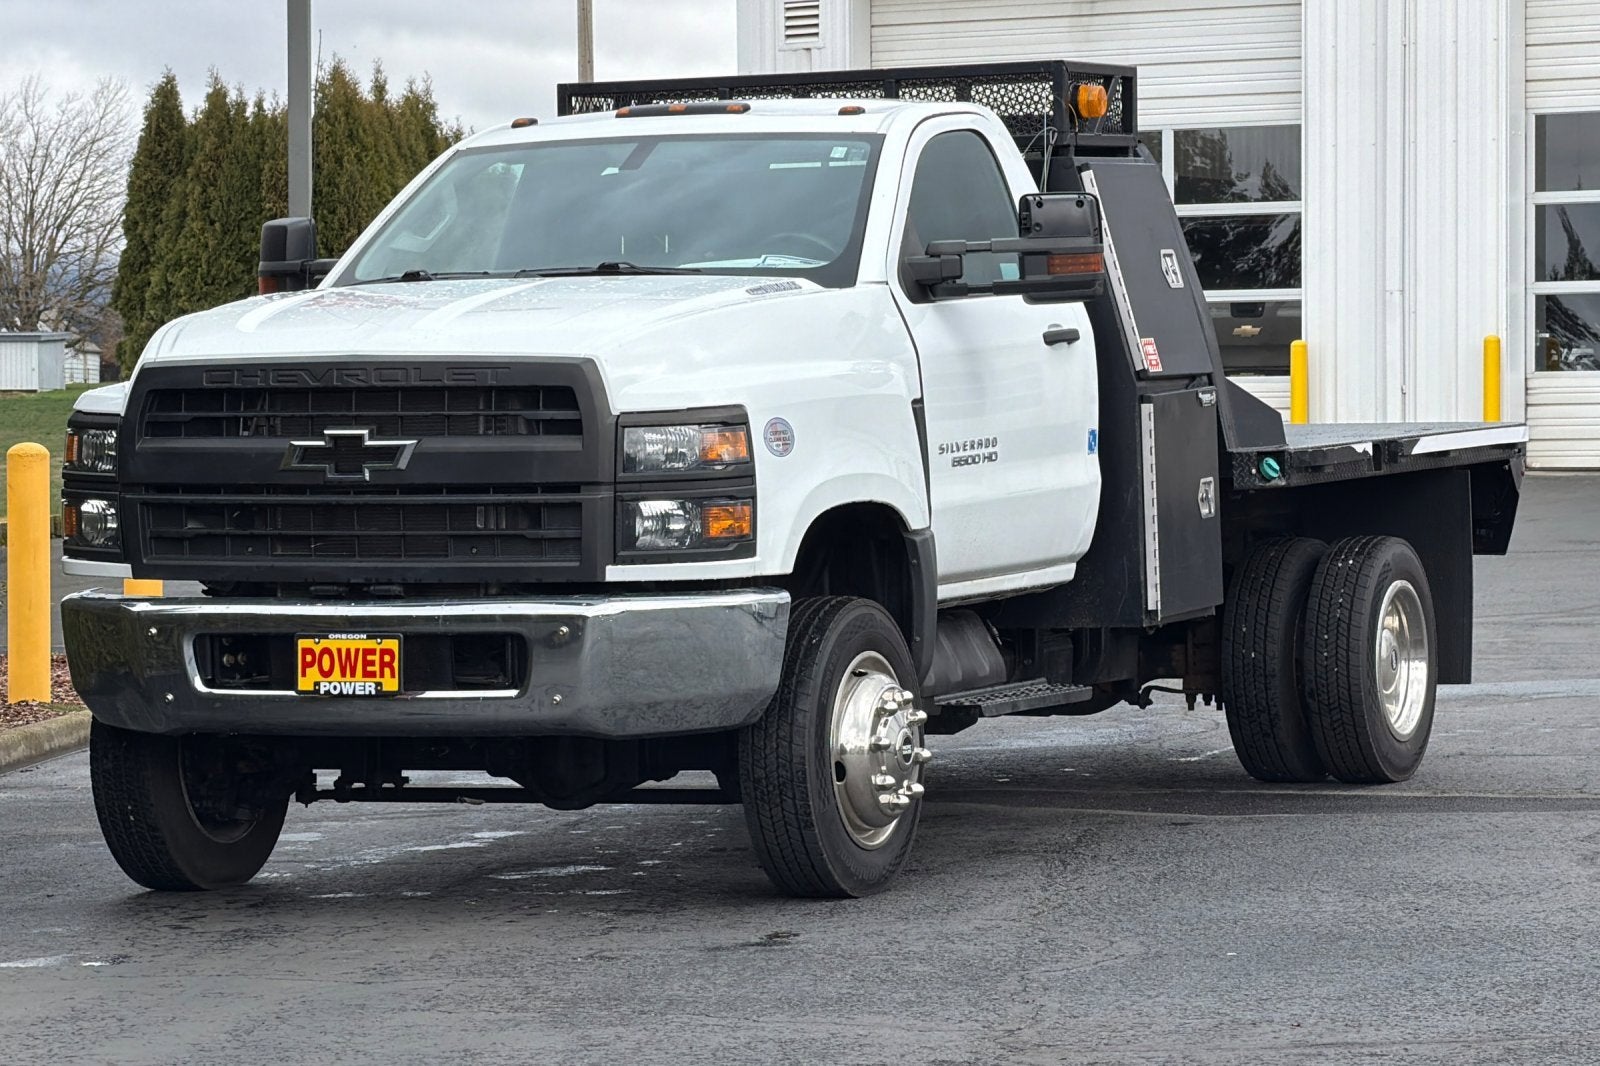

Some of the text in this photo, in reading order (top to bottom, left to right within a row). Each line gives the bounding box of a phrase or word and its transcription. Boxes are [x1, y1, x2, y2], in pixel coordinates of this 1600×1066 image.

[202, 366, 511, 387] CHEVROLET
[938, 436, 998, 455] SILVERADO
[301, 647, 396, 679] POWER
[319, 681, 377, 695] POWER
